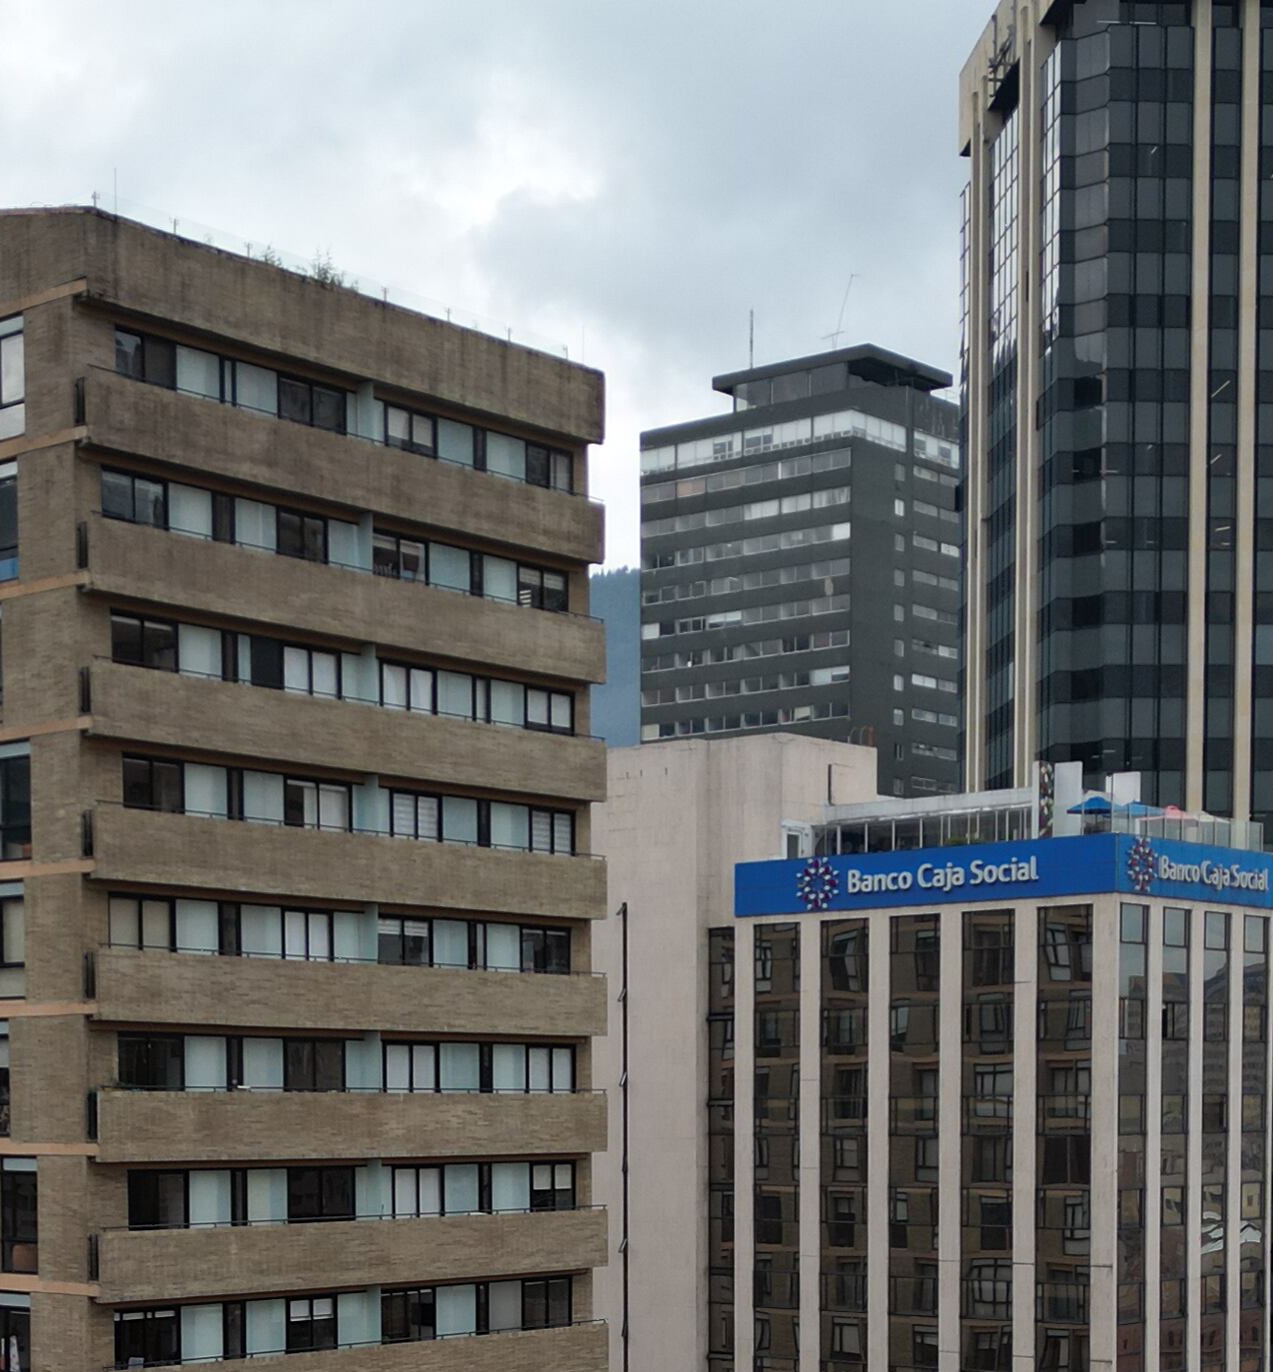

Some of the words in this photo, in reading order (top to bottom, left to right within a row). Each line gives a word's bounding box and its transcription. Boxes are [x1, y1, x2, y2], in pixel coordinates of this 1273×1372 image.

[847, 869, 913, 893] Banco
[917, 862, 966, 891] Caja
[969, 855, 1039, 885] Social
[1159, 855, 1200, 882] Banco
[1201, 860, 1230, 890] Caja
[1230, 864, 1269, 891] Social
